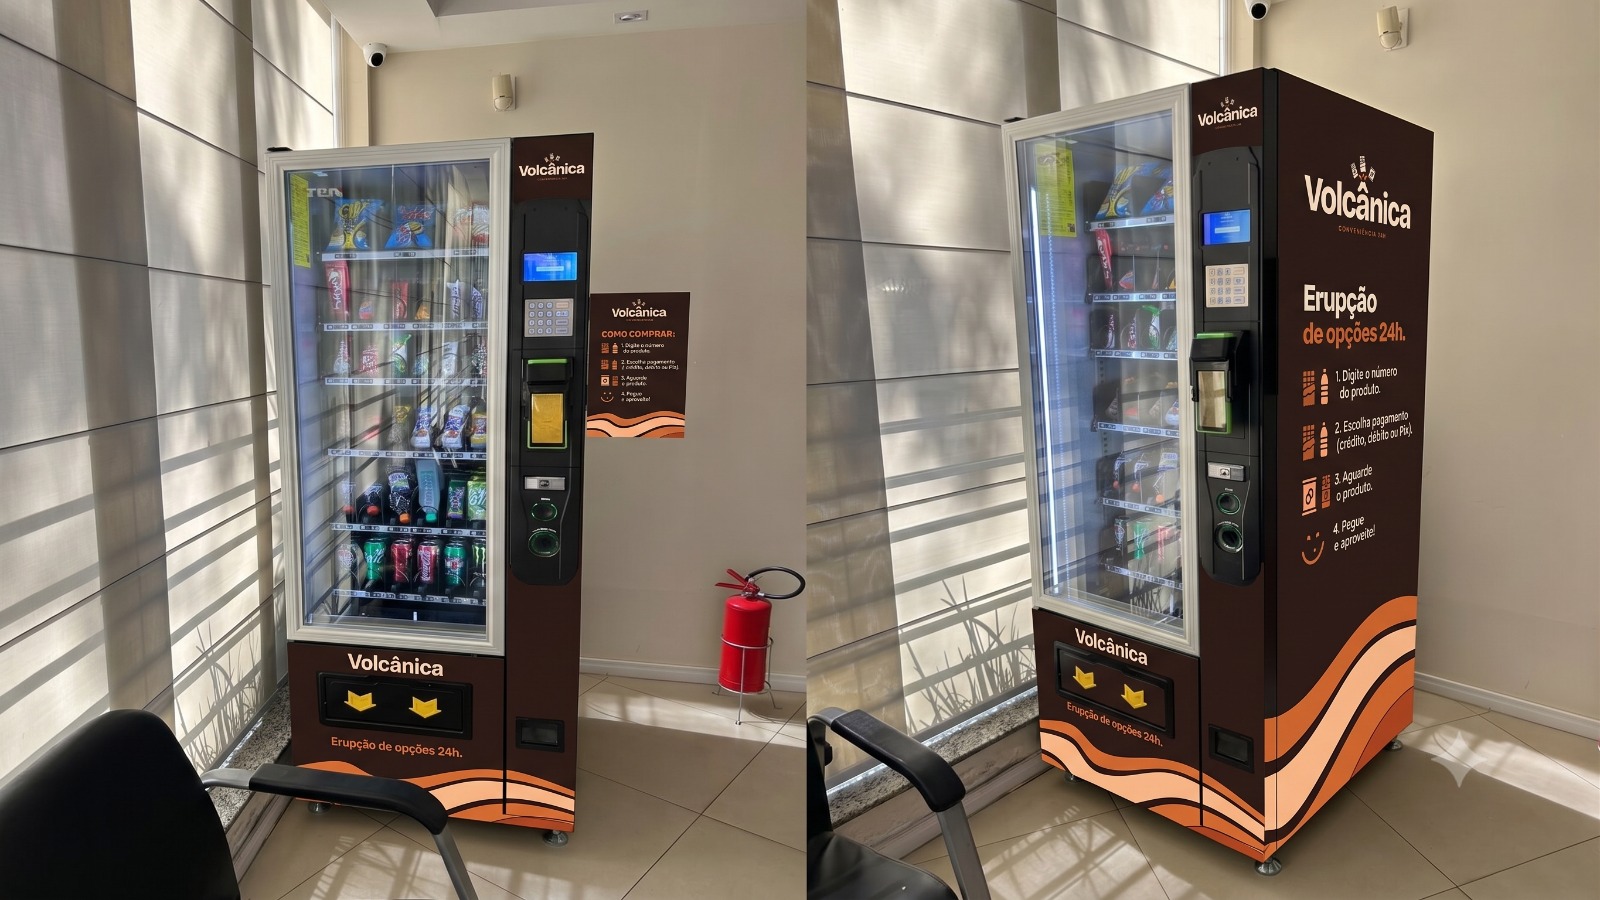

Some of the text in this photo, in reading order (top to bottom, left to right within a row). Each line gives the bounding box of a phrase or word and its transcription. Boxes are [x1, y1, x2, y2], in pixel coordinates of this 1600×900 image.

[1198, 106, 1258, 126] Volcânica
[518, 162, 584, 176] Volcânica
[1304, 174, 1411, 229] Volcânica
[612, 306, 667, 318] Volcânica
[1303, 284, 1378, 319] Erupção
[1303, 321, 1406, 349] de opções 24h.
[1336, 366, 1397, 384] 1. Digite o número
[1339, 384, 1380, 401] do produto.
[1335, 411, 1408, 434] 2. Escolha pagamento
[1336, 434, 1366, 454] (crédito,
[1368, 429, 1389, 445] débito
[1390, 429, 1398, 439] ou
[1334, 464, 1372, 485] 3. Aguarde
[1336, 481, 1372, 501] o produto.
[1333, 515, 1364, 534] 4. Pegue
[1334, 524, 1376, 551] e aproveite!
[1074, 628, 1148, 666] Volcânica
[348, 653, 444, 677] Volcânica
[1067, 702, 1163, 747] Erupção de opções 24h.
[331, 736, 463, 758] Erupção de opções 24h.
